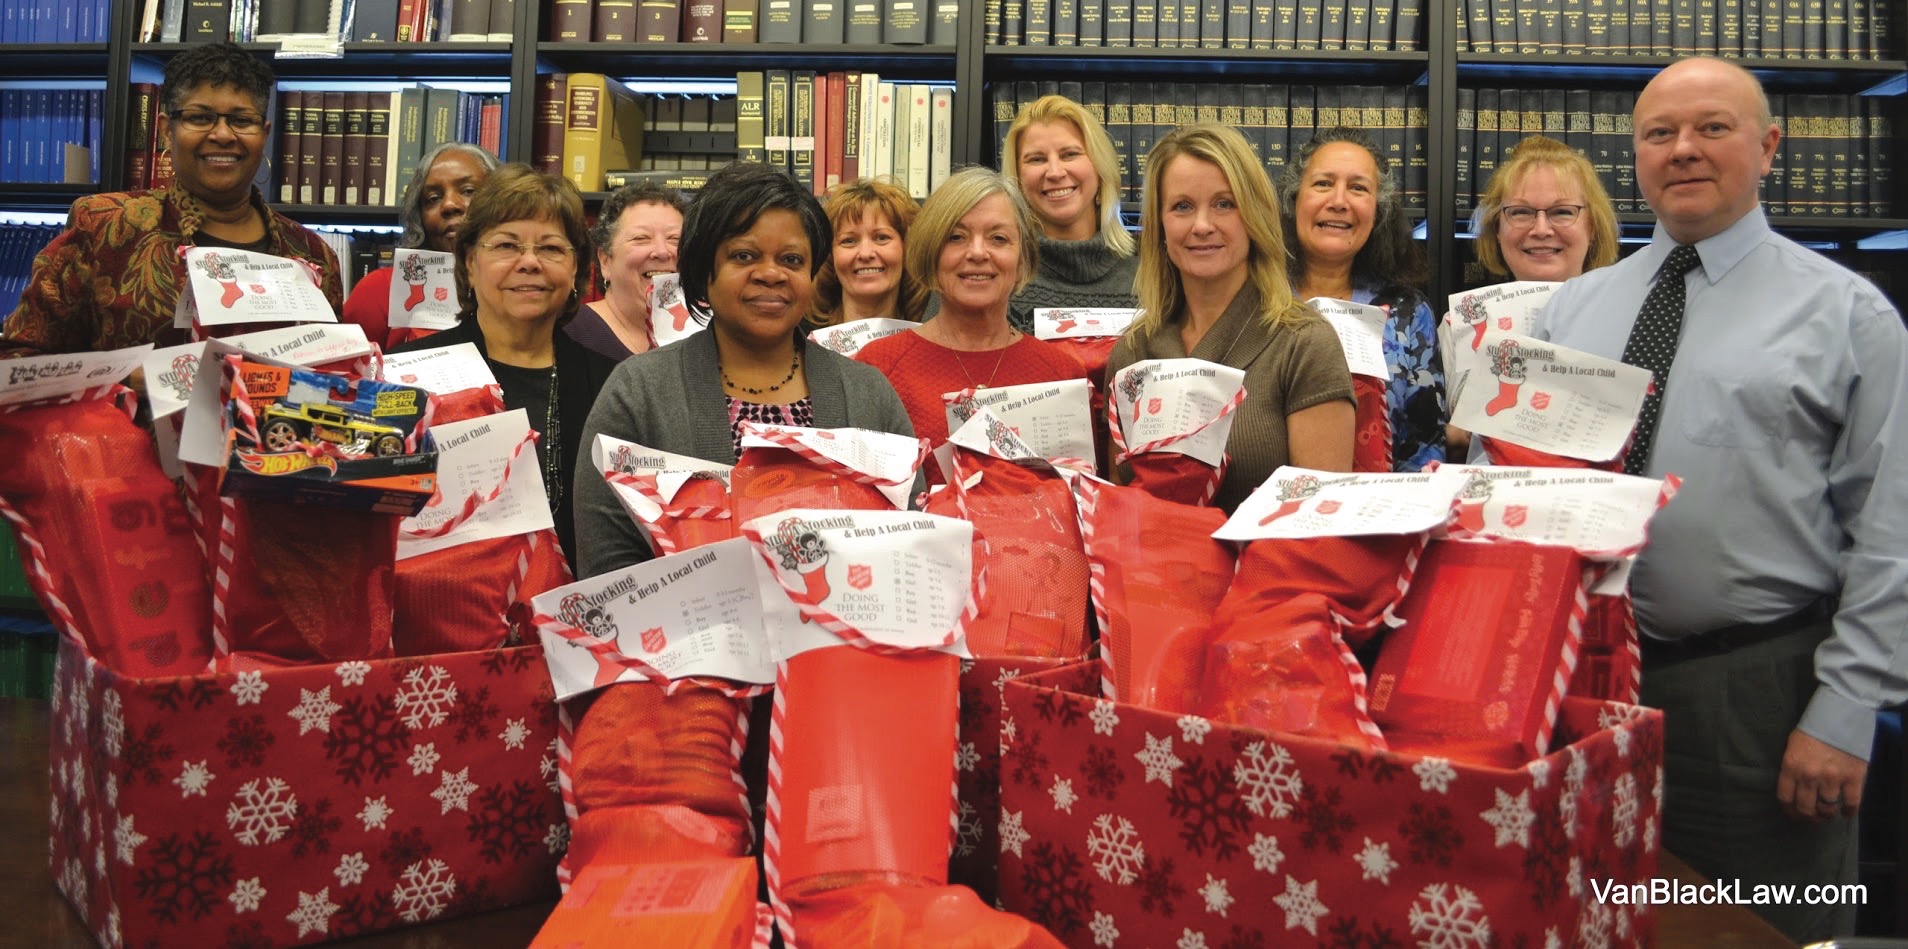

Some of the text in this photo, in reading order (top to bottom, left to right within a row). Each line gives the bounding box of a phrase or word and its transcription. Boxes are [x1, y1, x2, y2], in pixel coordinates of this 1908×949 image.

[741, 103, 760, 111] ALR
[278, 337, 302, 354] Local
[303, 329, 326, 344] Child
[1517, 347, 1555, 361] Stocking
[276, 372, 281, 381] &
[1160, 372, 1173, 381] Help
[1200, 369, 1215, 377] Child
[1542, 364, 1616, 378] & Help A Local Child
[247, 383, 276, 393] OUNDS
[378, 392, 414, 400] HIGH-SPEED
[1001, 405, 1006, 413] &
[1008, 402, 1022, 411] Help
[1028, 394, 1044, 403] Local
[1045, 388, 1060, 398] Child
[440, 424, 491, 452] A Local Child
[259, 454, 289, 474] HOT
[628, 452, 665, 468] Stocking
[1524, 478, 1547, 487] Help
[1559, 477, 1586, 485] Local
[420, 507, 451, 520] DOING
[416, 521, 433, 530] THE
[802, 515, 855, 532] Stocking
[844, 520, 936, 538] & Help A Local Child
[628, 551, 717, 604] & Help A Local Child
[585, 574, 638, 609] Stocking
[843, 592, 879, 603] DOING
[836, 603, 885, 612] THE MOST
[844, 612, 877, 621] GOOD
